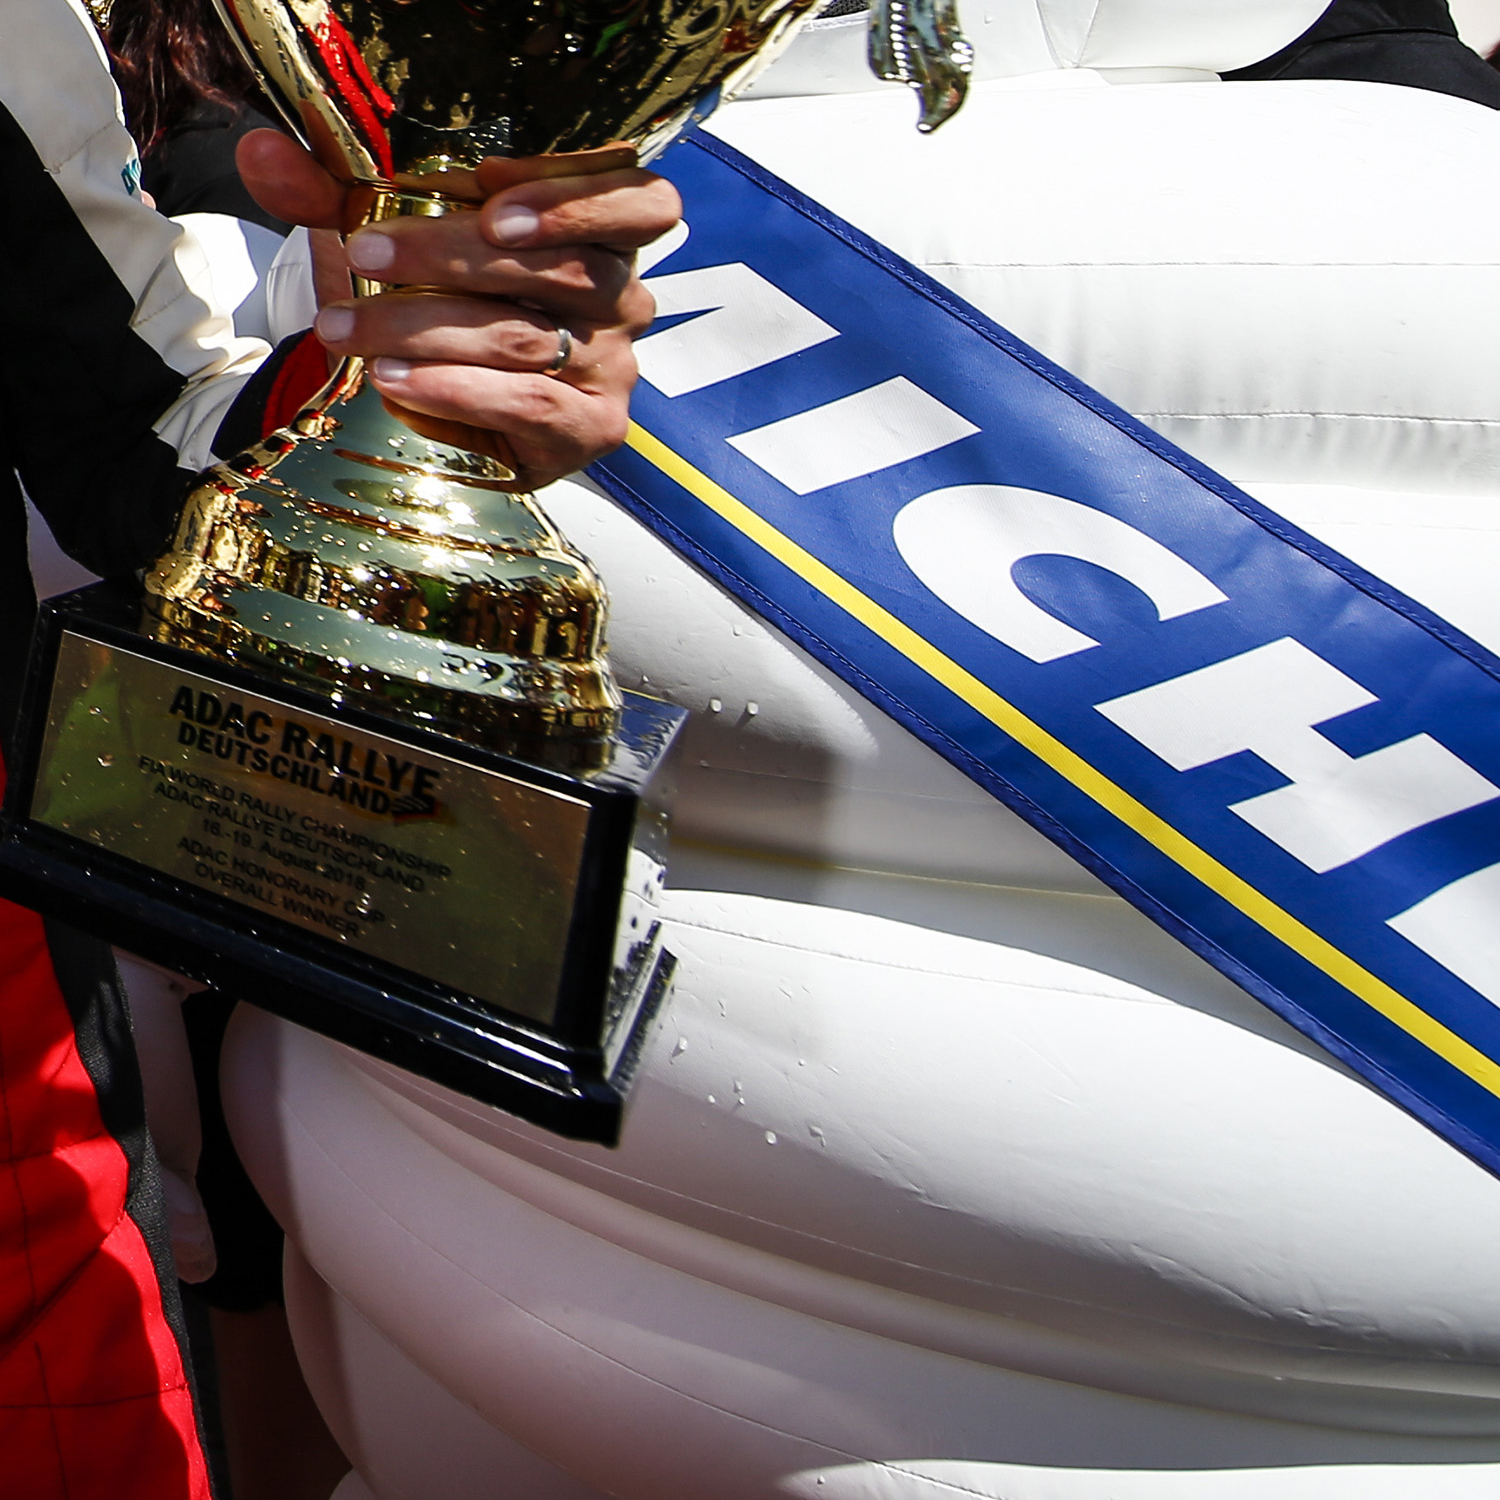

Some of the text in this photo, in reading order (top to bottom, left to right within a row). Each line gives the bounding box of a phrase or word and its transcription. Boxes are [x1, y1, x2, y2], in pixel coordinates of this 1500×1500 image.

[169, 685, 440, 799] ADAC RALLYE
[177, 721, 392, 816] DEUTSCHLAND
[154, 780, 426, 893] ADAC RALLYE DEUTSCHLAND
[167, 764, 234, 802] WORLD
[239, 791, 297, 824] RALLY
[300, 814, 452, 879] CHAMPIONSHIP
[177, 836, 228, 868] ADAC
[231, 853, 341, 908] HONORARY
[195, 863, 360, 939] OVERALL WINNER
